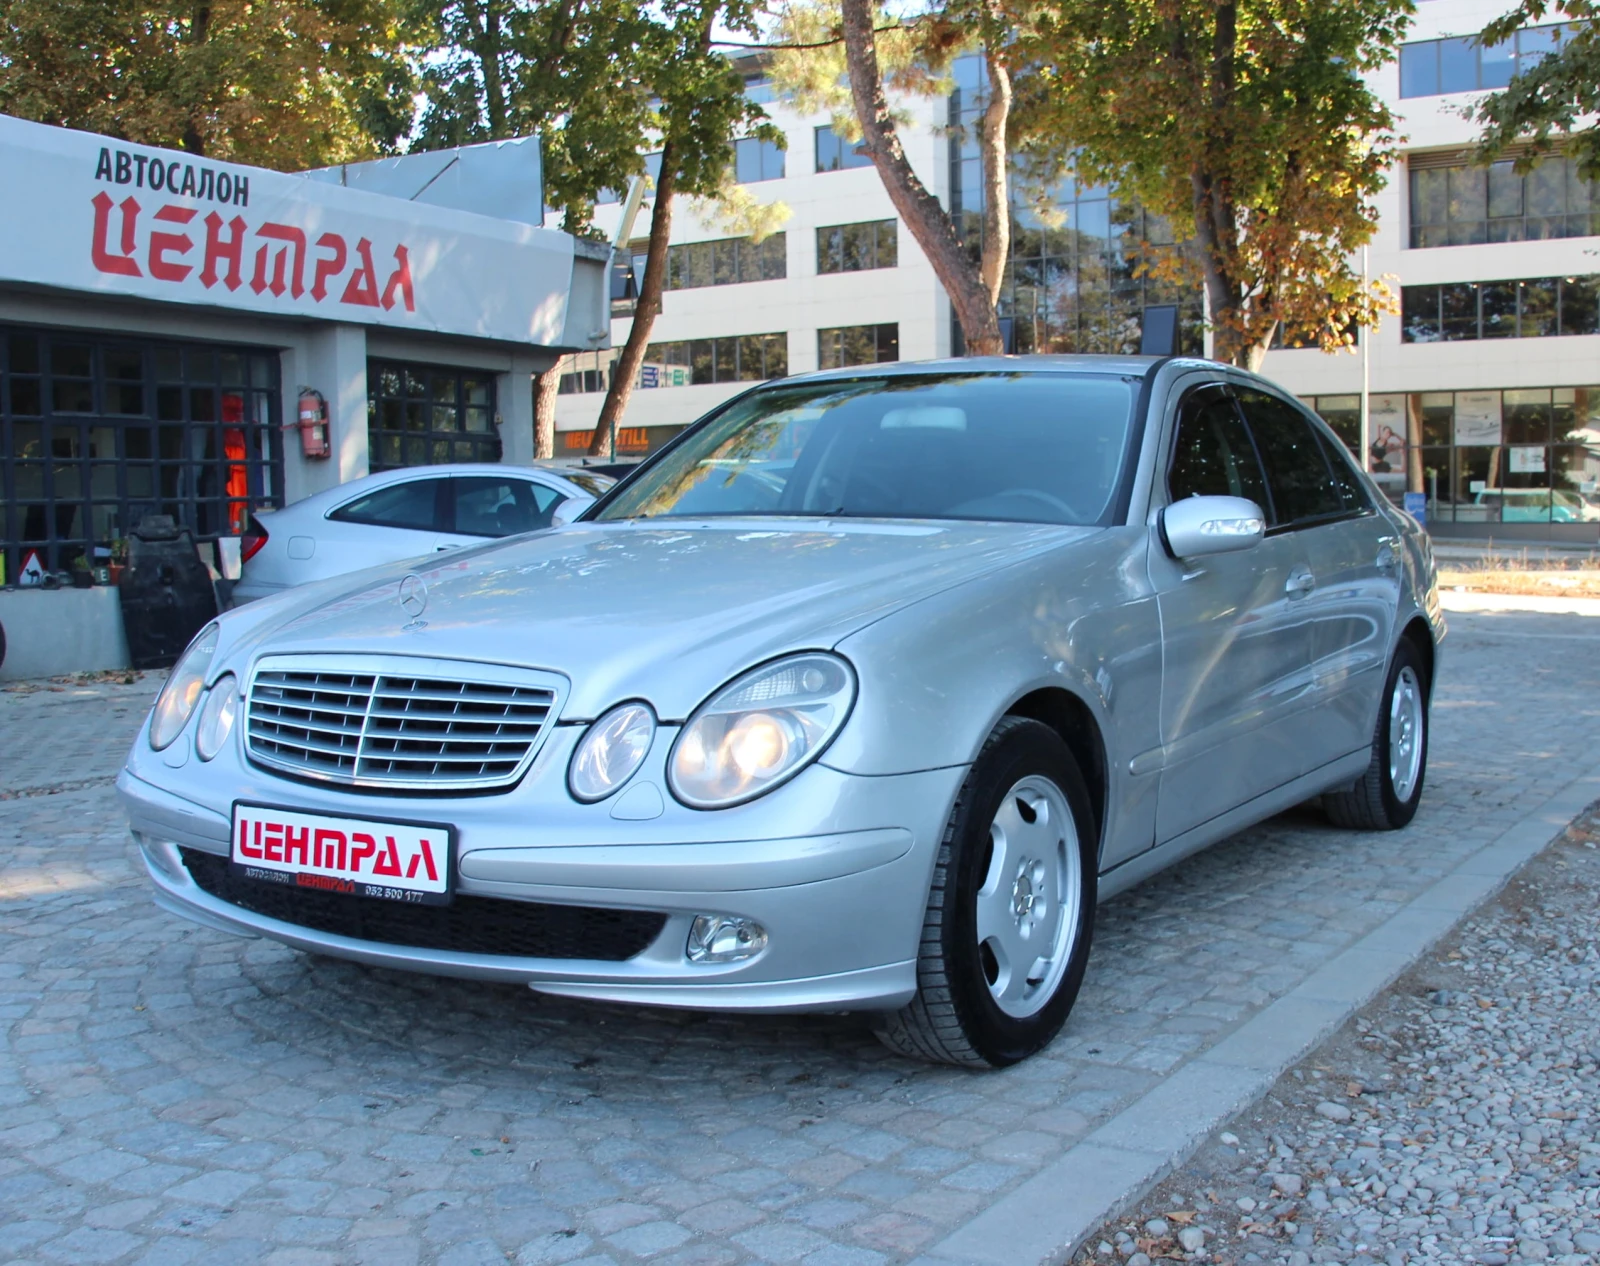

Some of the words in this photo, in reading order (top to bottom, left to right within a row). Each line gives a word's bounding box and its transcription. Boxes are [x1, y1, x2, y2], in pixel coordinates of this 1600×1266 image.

[95, 147, 249, 207] АВТОСАЛОН
[91, 190, 415, 312] ЦЕНТРАЛ
[240, 819, 438, 881] ЦЕНТРАЛ
[404, 890, 424, 902] 177
